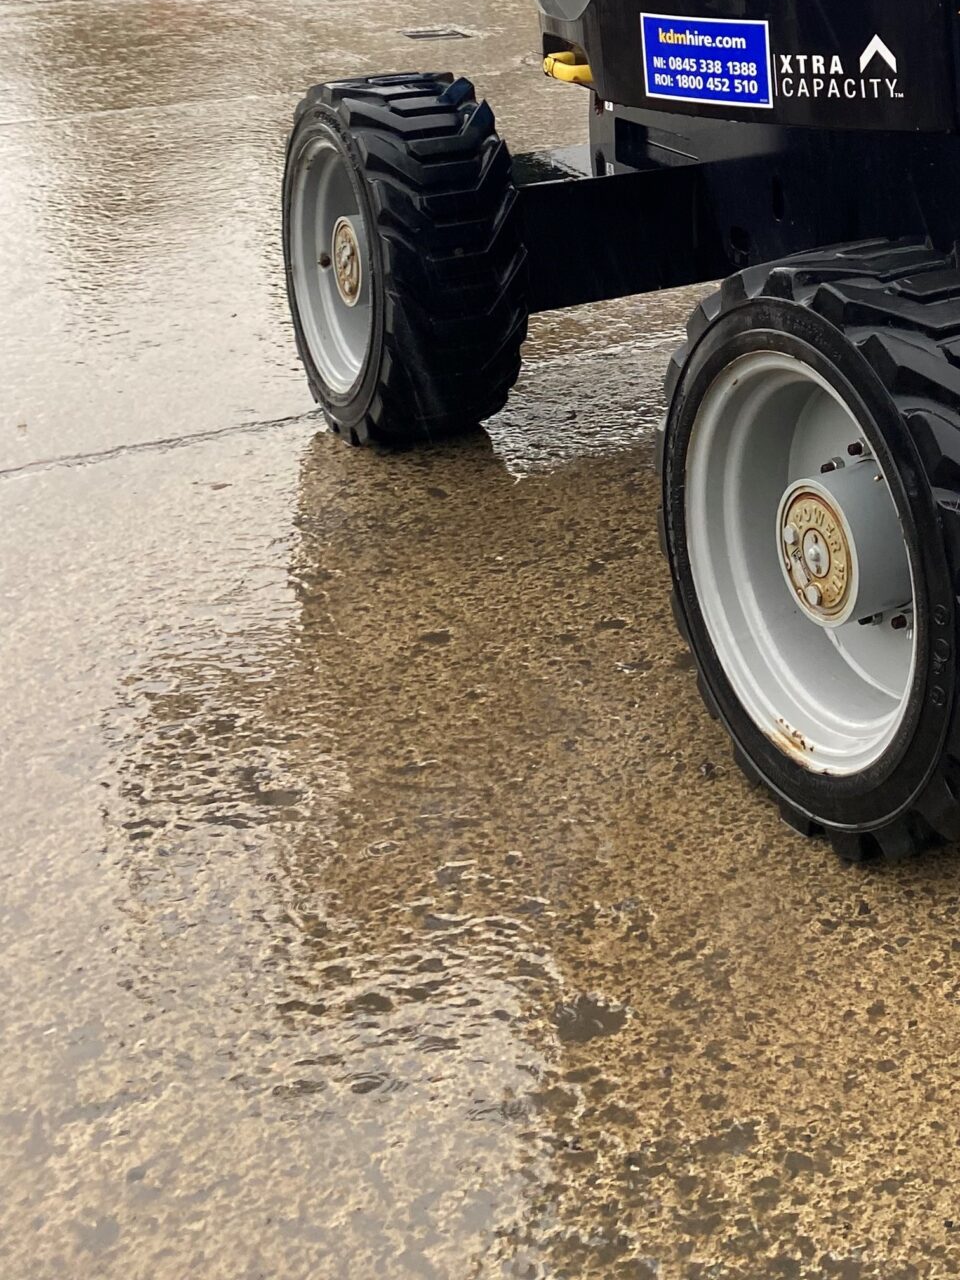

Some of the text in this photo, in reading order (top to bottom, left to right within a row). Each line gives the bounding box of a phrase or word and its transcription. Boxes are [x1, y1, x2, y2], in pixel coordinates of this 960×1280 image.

[658, 27, 747, 49] kdmhire.com
[653, 56, 758, 77] NI: 0845 338 1388
[780, 54, 844, 74] XTRA
[654, 73, 758, 94] ROI: 1800 452 510
[782, 77, 897, 98] CAPACITY
